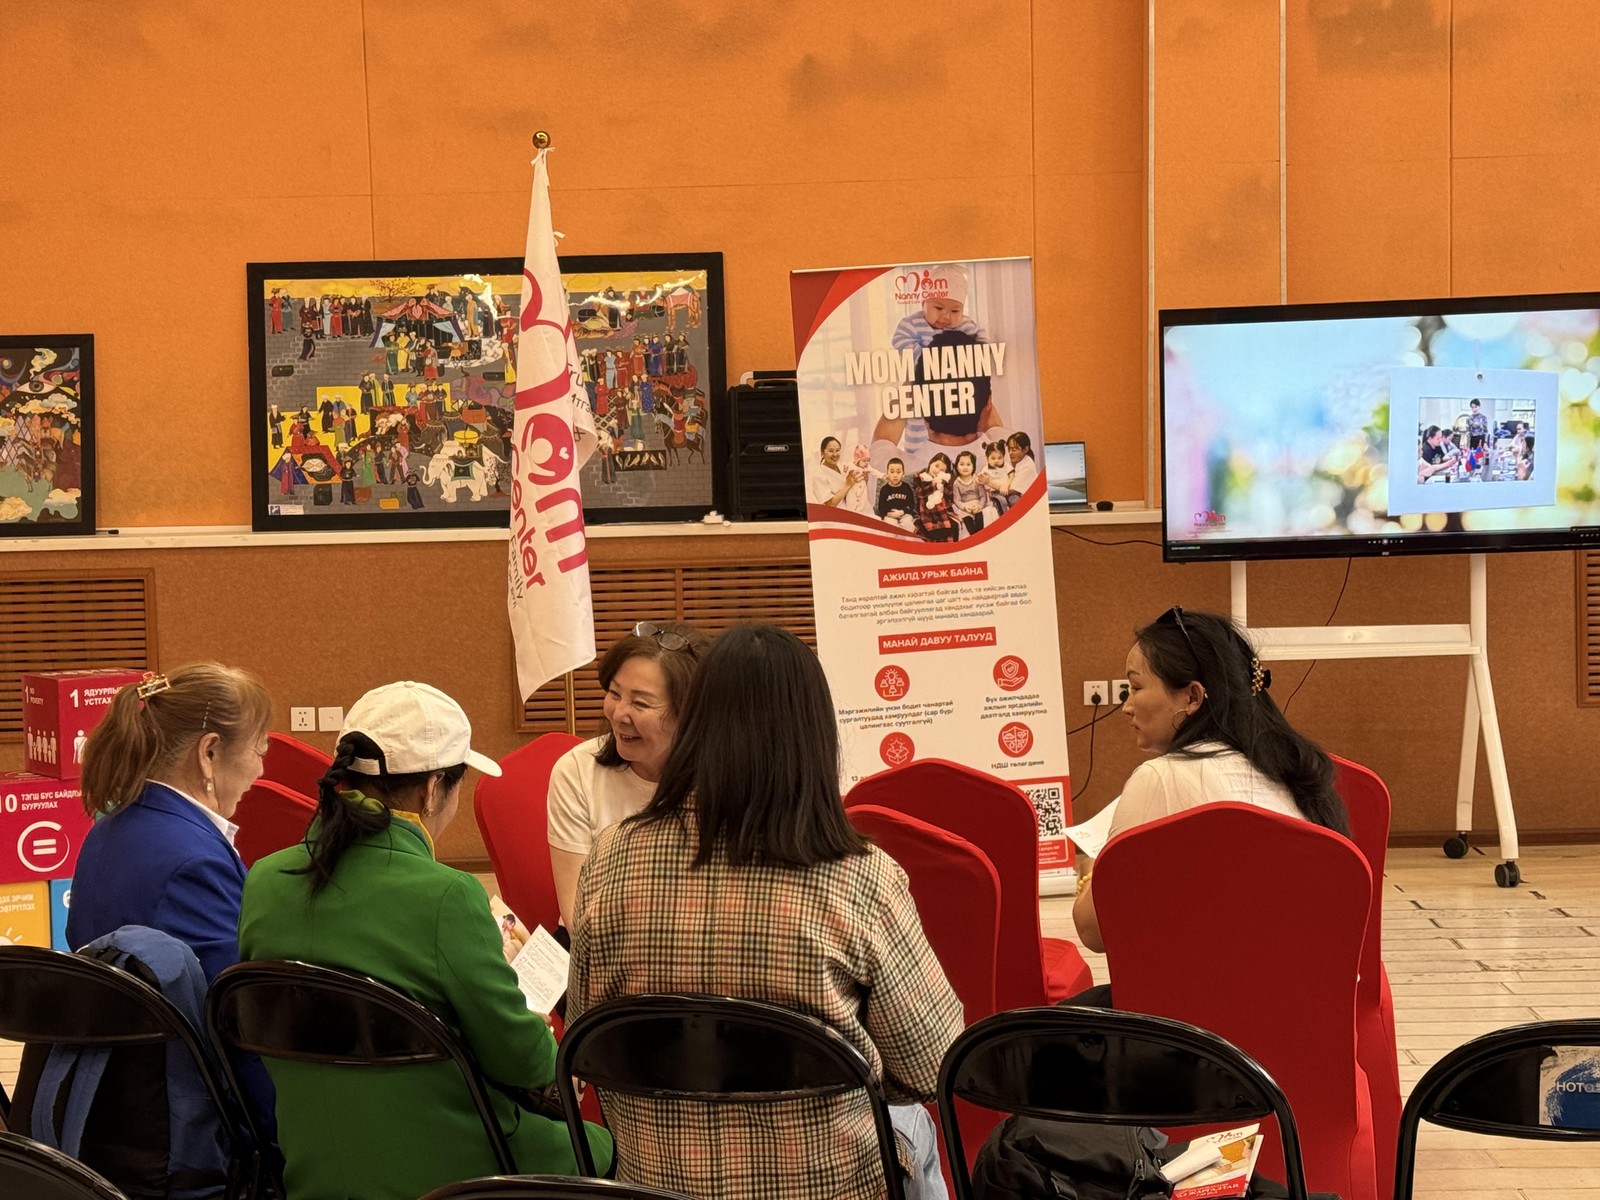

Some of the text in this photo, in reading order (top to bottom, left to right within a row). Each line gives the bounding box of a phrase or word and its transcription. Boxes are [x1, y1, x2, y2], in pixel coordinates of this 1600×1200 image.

[895, 269, 948, 292] Mom
[922, 290, 948, 298] Center
[845, 342, 1006, 386] MOM NANNY
[881, 382, 976, 420] CENTER
[510, 534, 525, 600] Family
[882, 566, 984, 582] АЖИЛД УРЬЖ БАЙНА
[883, 632, 993, 648] МАНАЙ ДАВУУ ТАЛУУД
[70, 689, 78, 708] 1
[84, 697, 112, 706] УСТГАХ
[0, 794, 18, 813] 0
[22, 801, 58, 810] БУУРУУЛАХ
